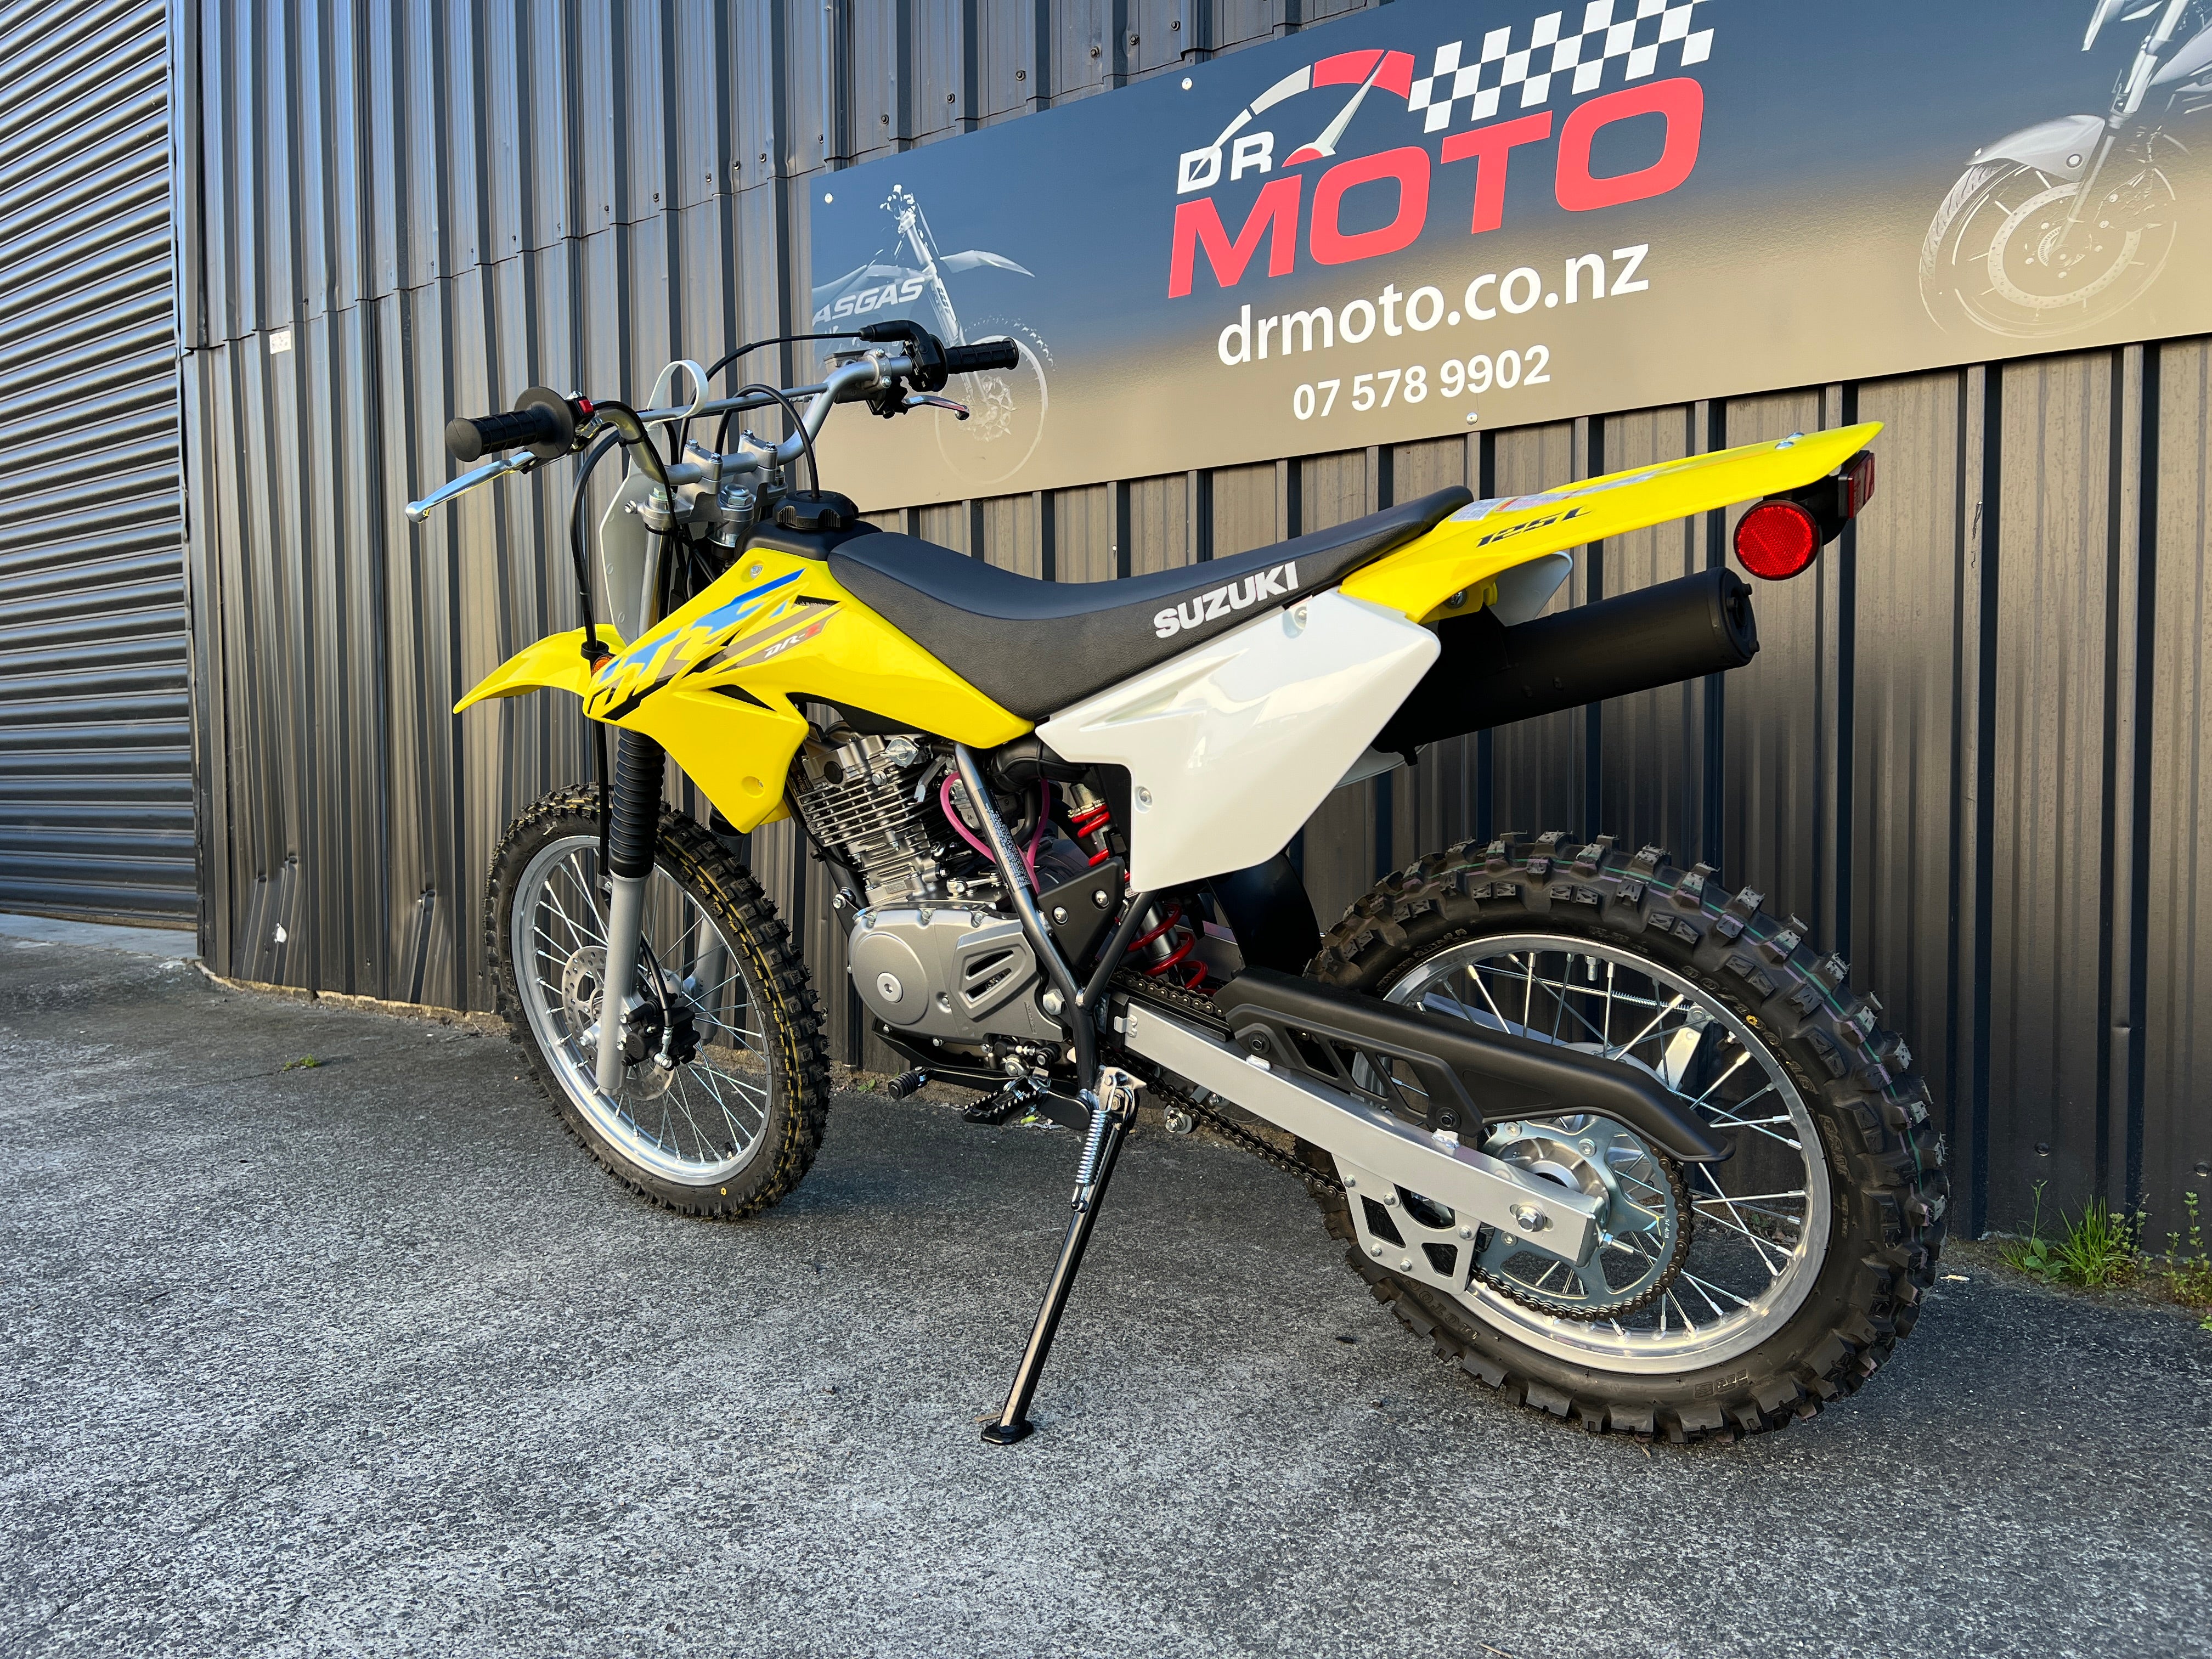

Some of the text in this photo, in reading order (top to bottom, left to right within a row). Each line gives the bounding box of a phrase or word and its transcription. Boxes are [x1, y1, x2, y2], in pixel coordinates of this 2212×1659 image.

[1168, 77, 1704, 298] MOTO
[1177, 131, 1274, 194] DR
[1217, 243, 1650, 366] drmoto.co.nz
[1293, 345, 1551, 420] 07 578 9902
[1476, 505, 1593, 548] 125L
[1154, 561, 1299, 639] SUZUKI
